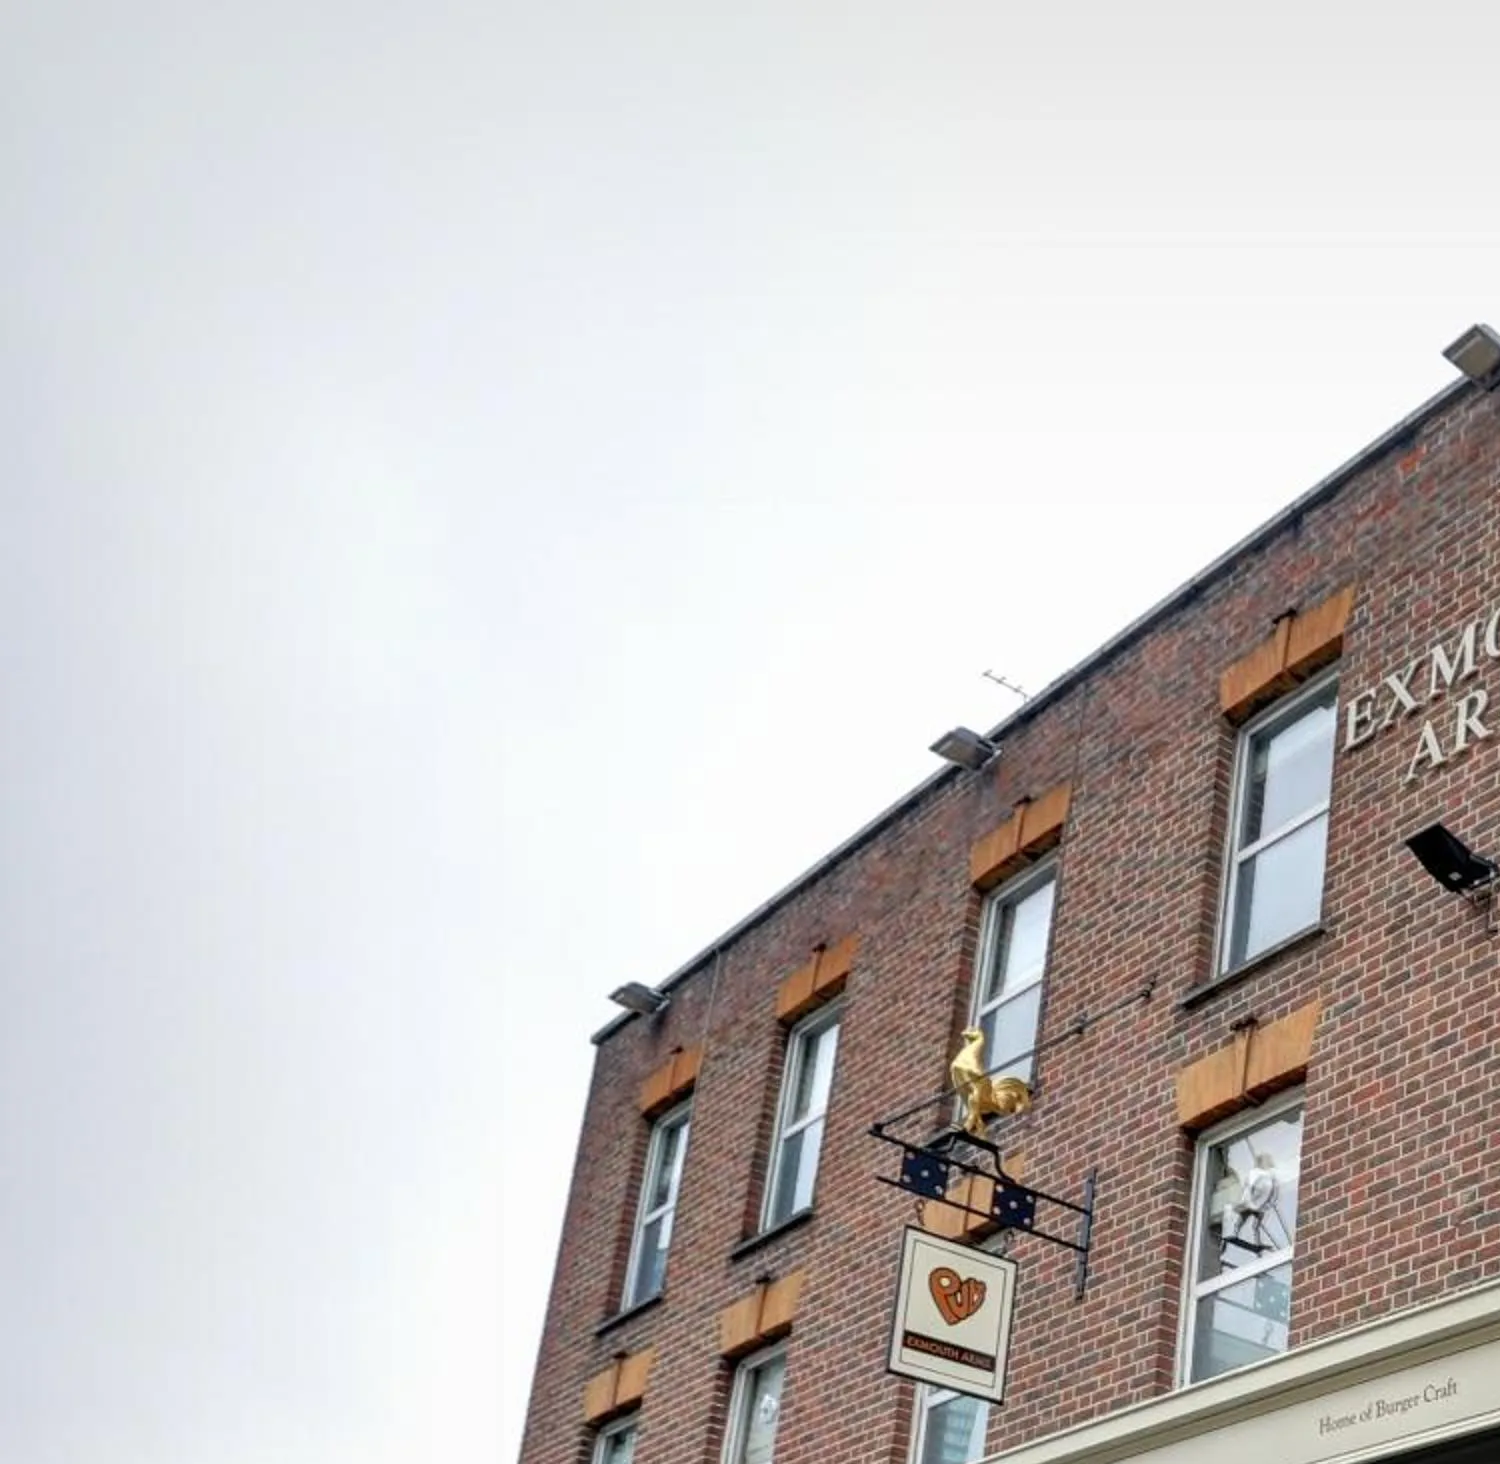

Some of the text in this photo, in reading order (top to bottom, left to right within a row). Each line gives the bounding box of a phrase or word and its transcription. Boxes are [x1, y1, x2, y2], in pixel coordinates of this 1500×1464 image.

[1319, 1377, 1457, 1437] Home of Burger Craft
